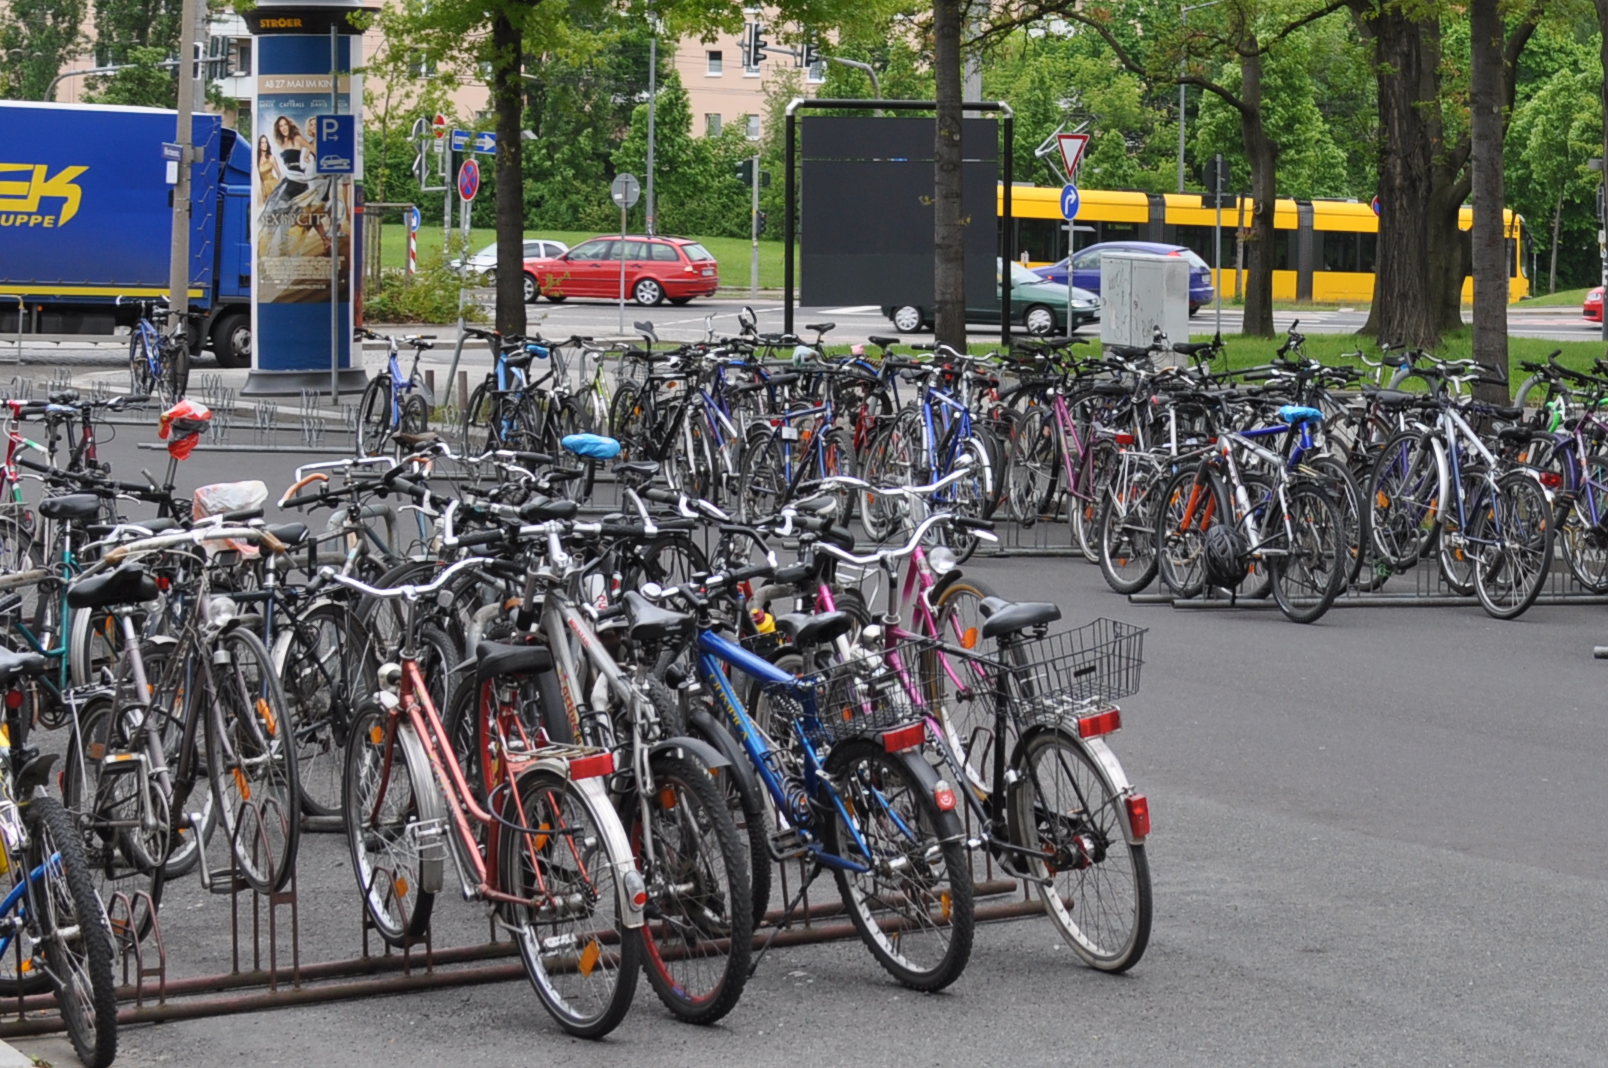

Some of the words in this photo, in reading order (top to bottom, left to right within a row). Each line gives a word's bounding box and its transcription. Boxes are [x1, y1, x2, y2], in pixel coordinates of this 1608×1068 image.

[265, 80, 274, 88] AB
[286, 80, 304, 88] MAI
[306, 79, 316, 87] IM
[323, 119, 339, 141] P
